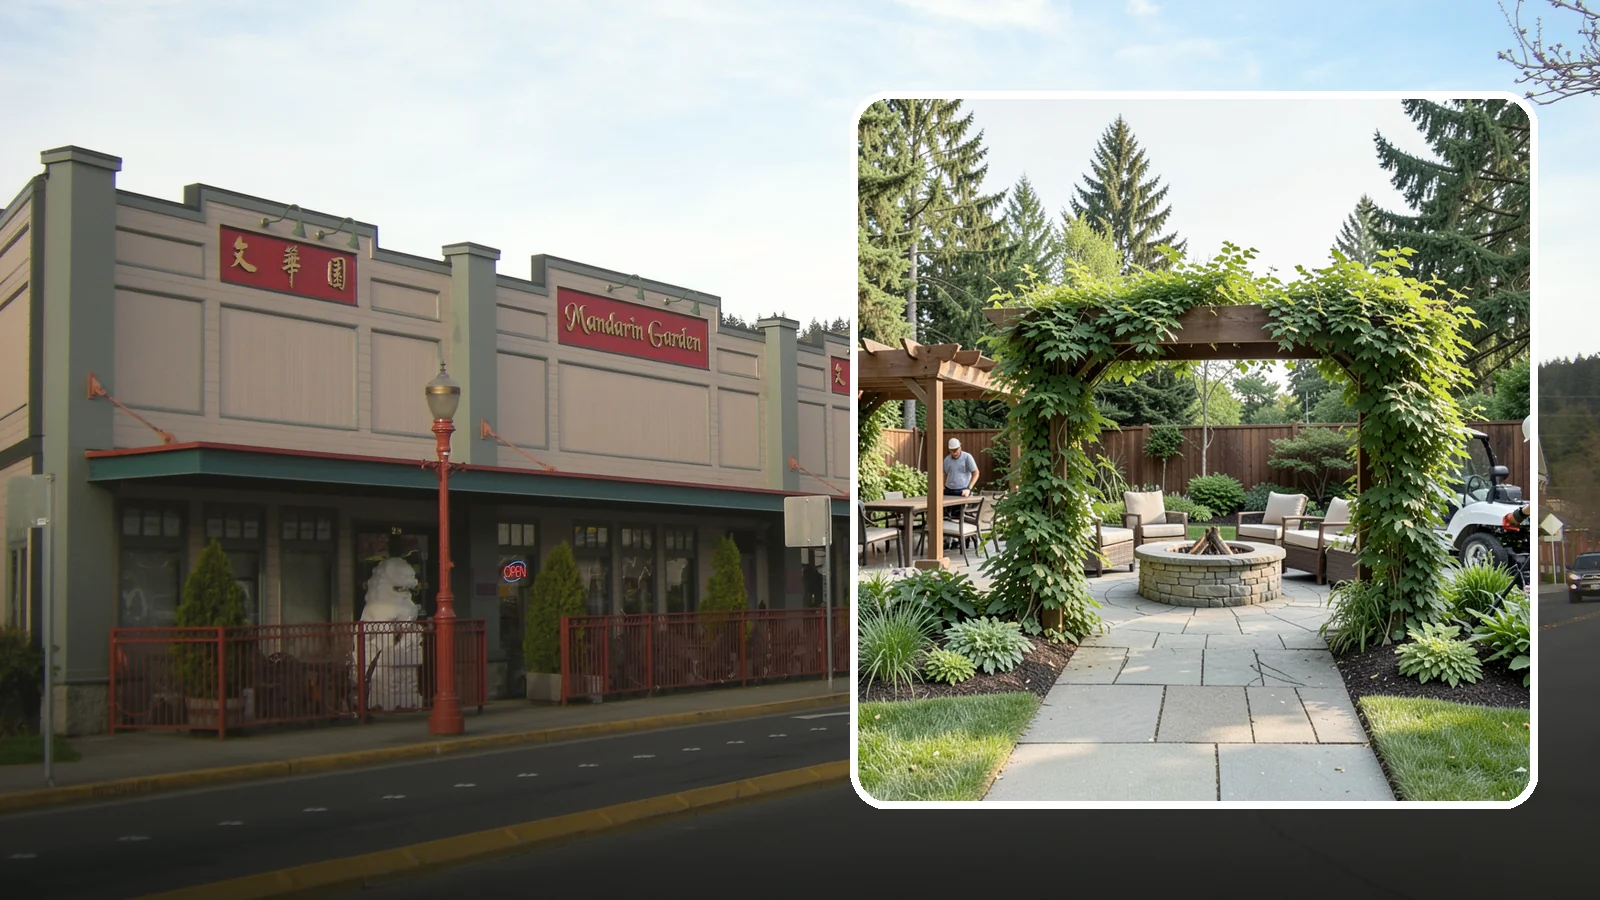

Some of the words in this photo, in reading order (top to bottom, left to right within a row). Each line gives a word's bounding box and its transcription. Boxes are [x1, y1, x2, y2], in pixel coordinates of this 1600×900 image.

[230, 235, 346, 291] 文華園
[564, 302, 644, 341] Mandarin
[648, 320, 702, 352] Garden
[835, 363, 846, 386] 文
[503, 565, 527, 578] OPEN
